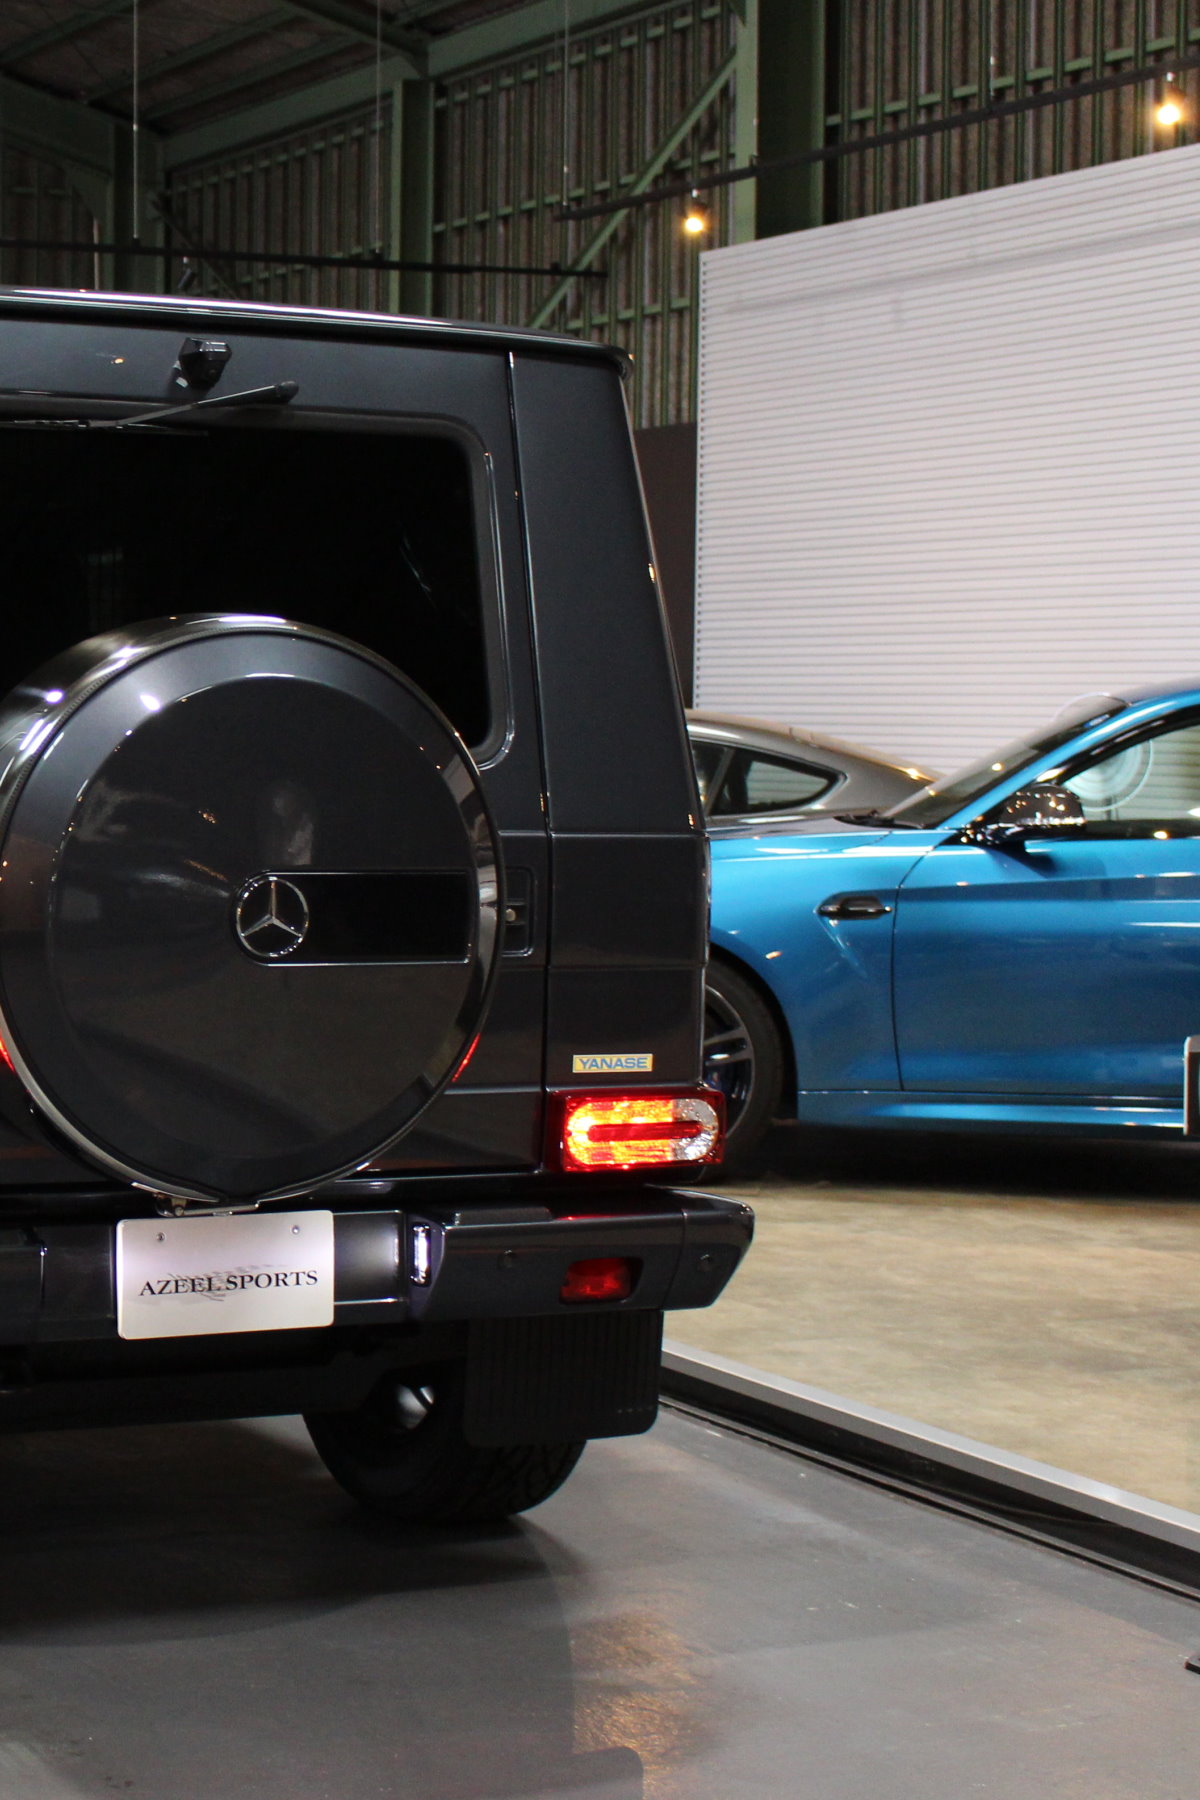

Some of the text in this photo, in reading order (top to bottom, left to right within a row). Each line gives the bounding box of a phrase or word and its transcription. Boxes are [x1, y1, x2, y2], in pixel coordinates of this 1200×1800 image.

[579, 1057, 648, 1070] YANASE
[138, 1270, 318, 1296] AZEEL SPORTS
